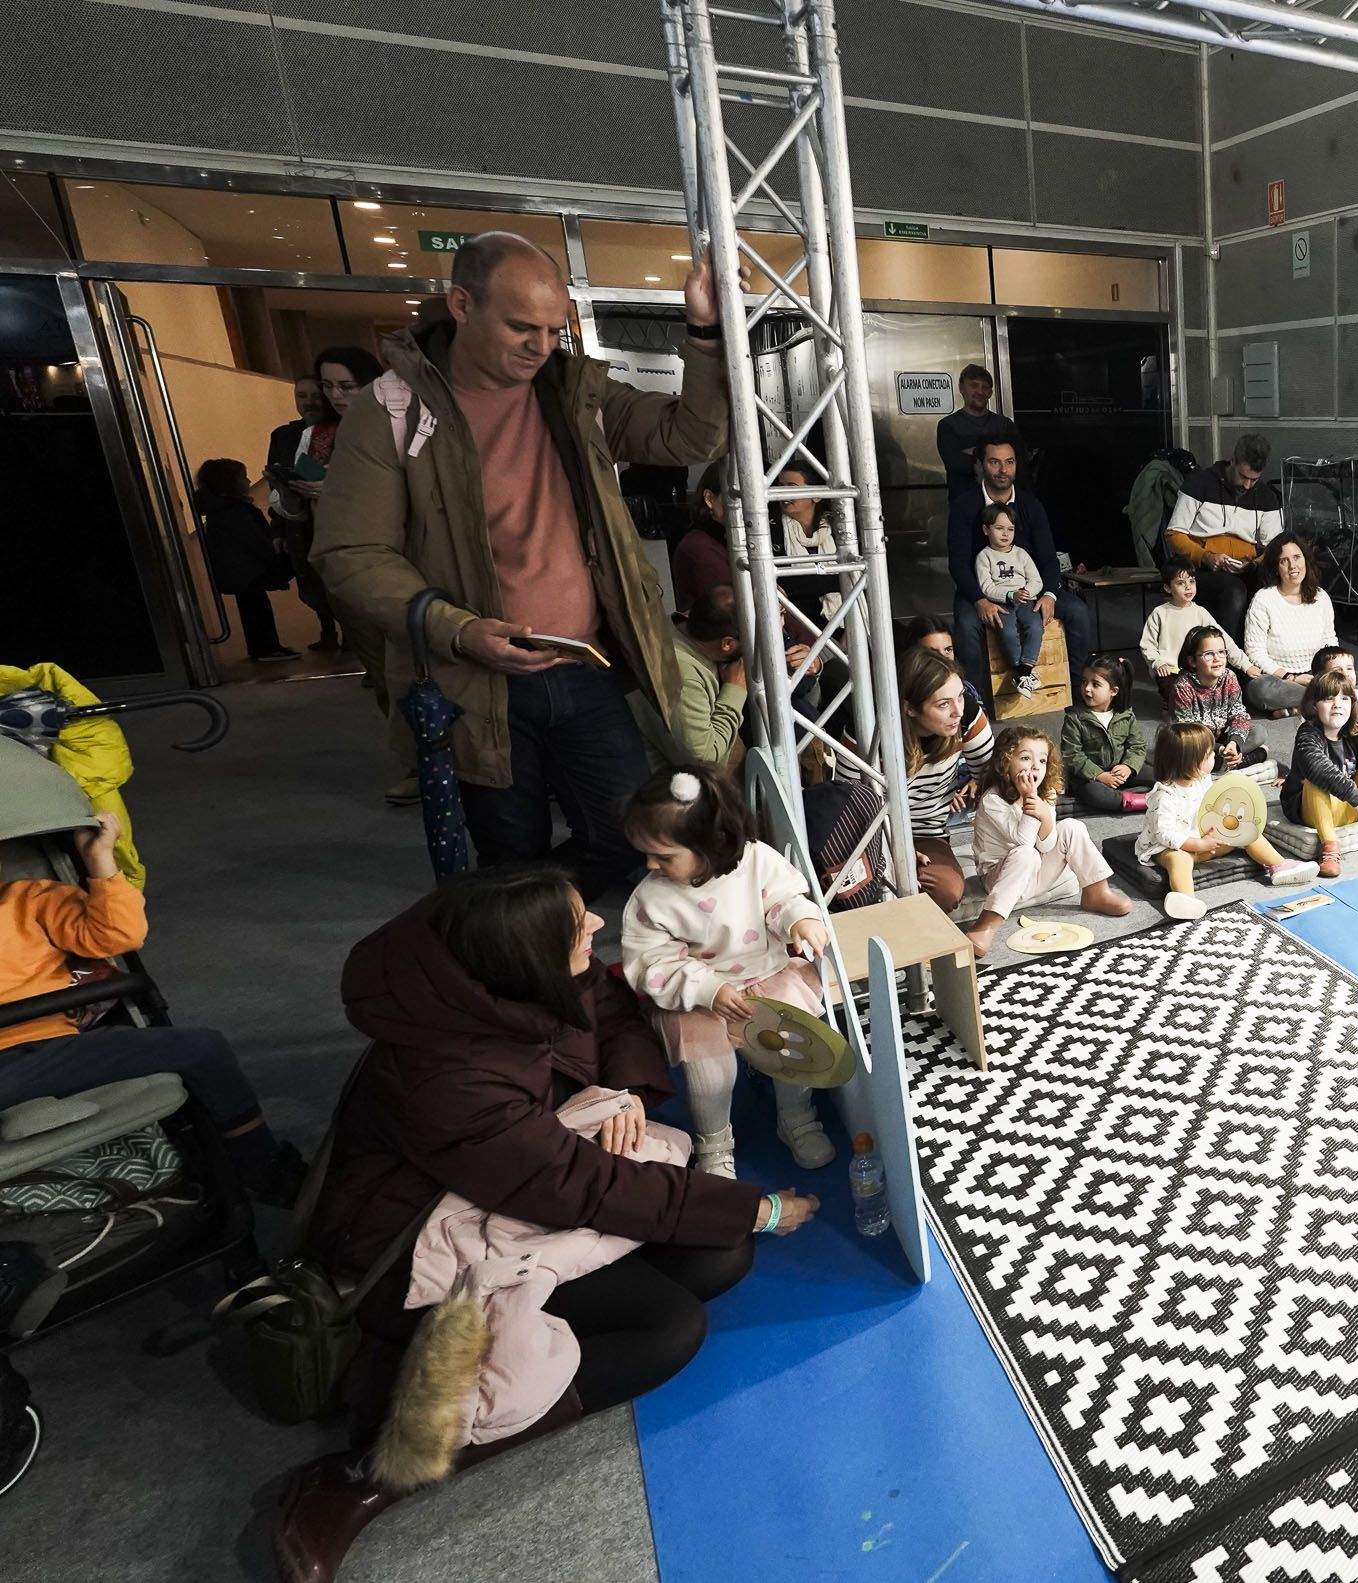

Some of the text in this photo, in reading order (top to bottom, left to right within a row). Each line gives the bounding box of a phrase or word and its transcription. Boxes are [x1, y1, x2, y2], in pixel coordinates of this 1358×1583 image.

[431, 236, 465, 250] SAÍ
[900, 379, 951, 390] ALARMA CONECTADA
[913, 397, 942, 408] NON PASEN
